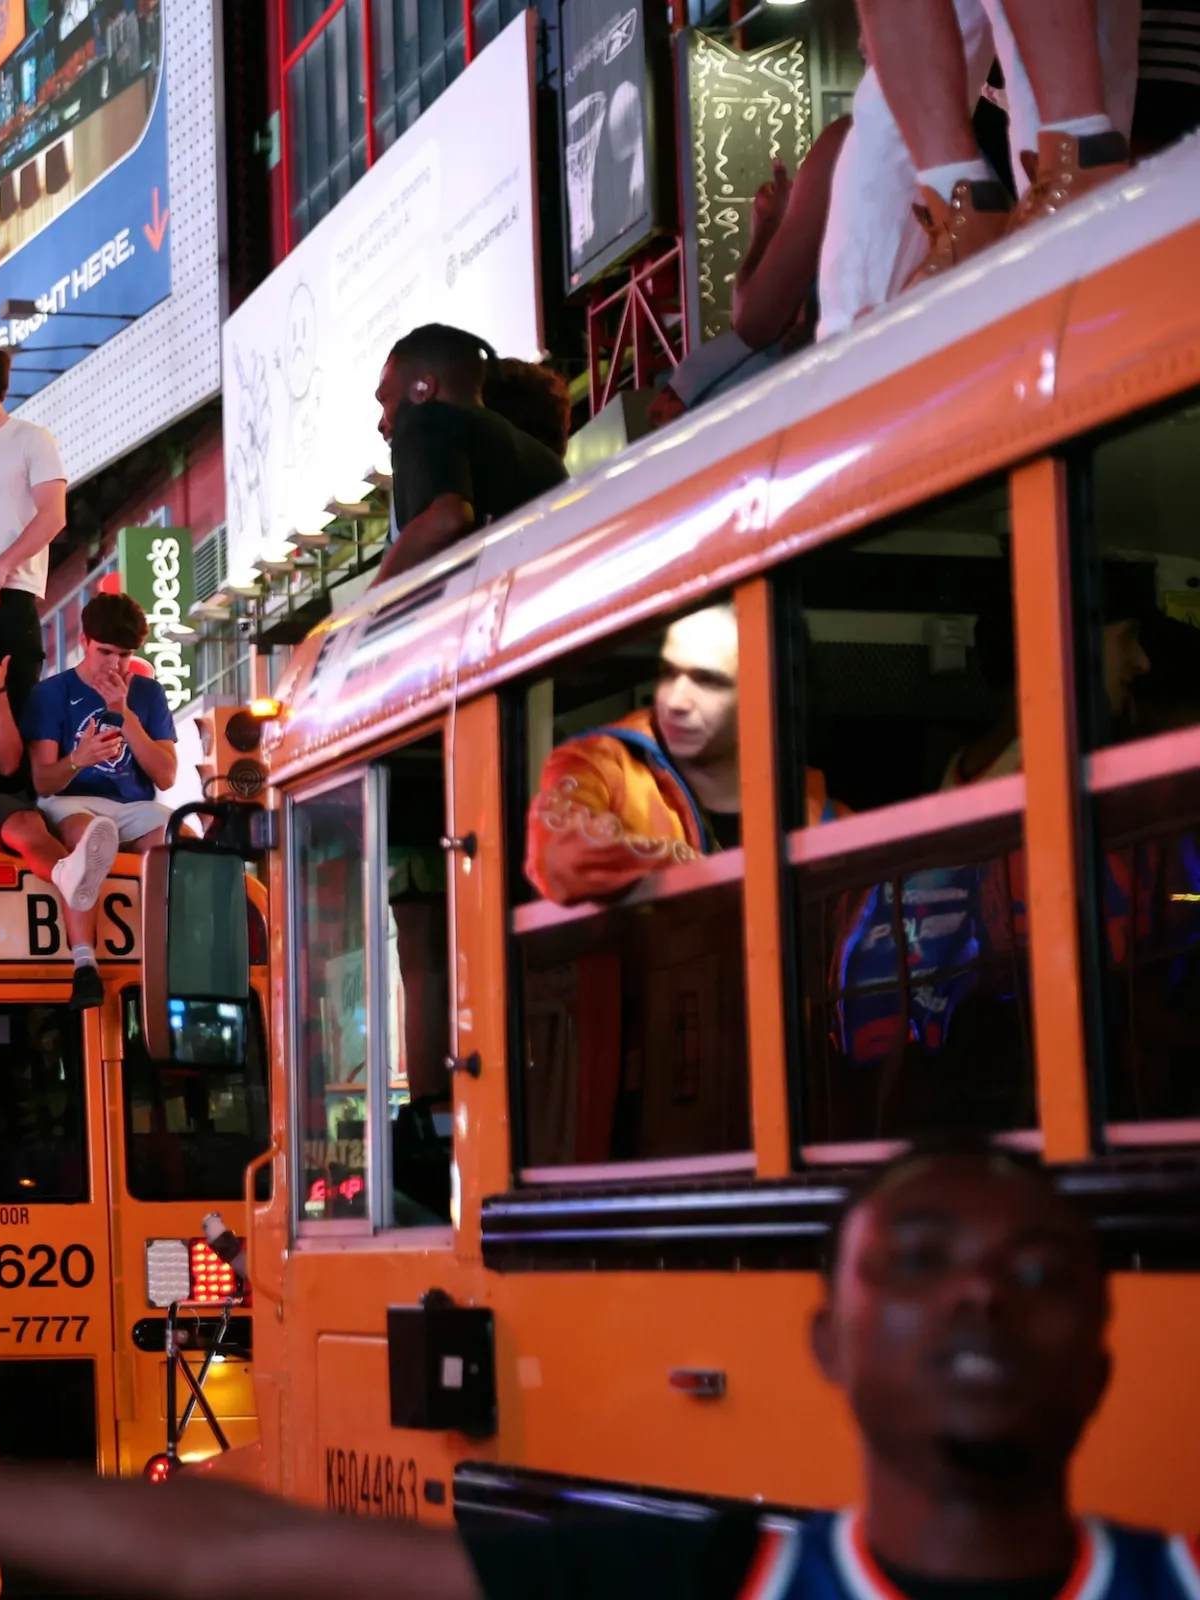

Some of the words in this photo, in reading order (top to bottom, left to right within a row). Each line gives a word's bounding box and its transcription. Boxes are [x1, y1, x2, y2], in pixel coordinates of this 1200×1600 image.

[71, 227, 136, 300] HERE.
[145, 537, 192, 714] pplbee's
[28, 892, 135, 957] BS
